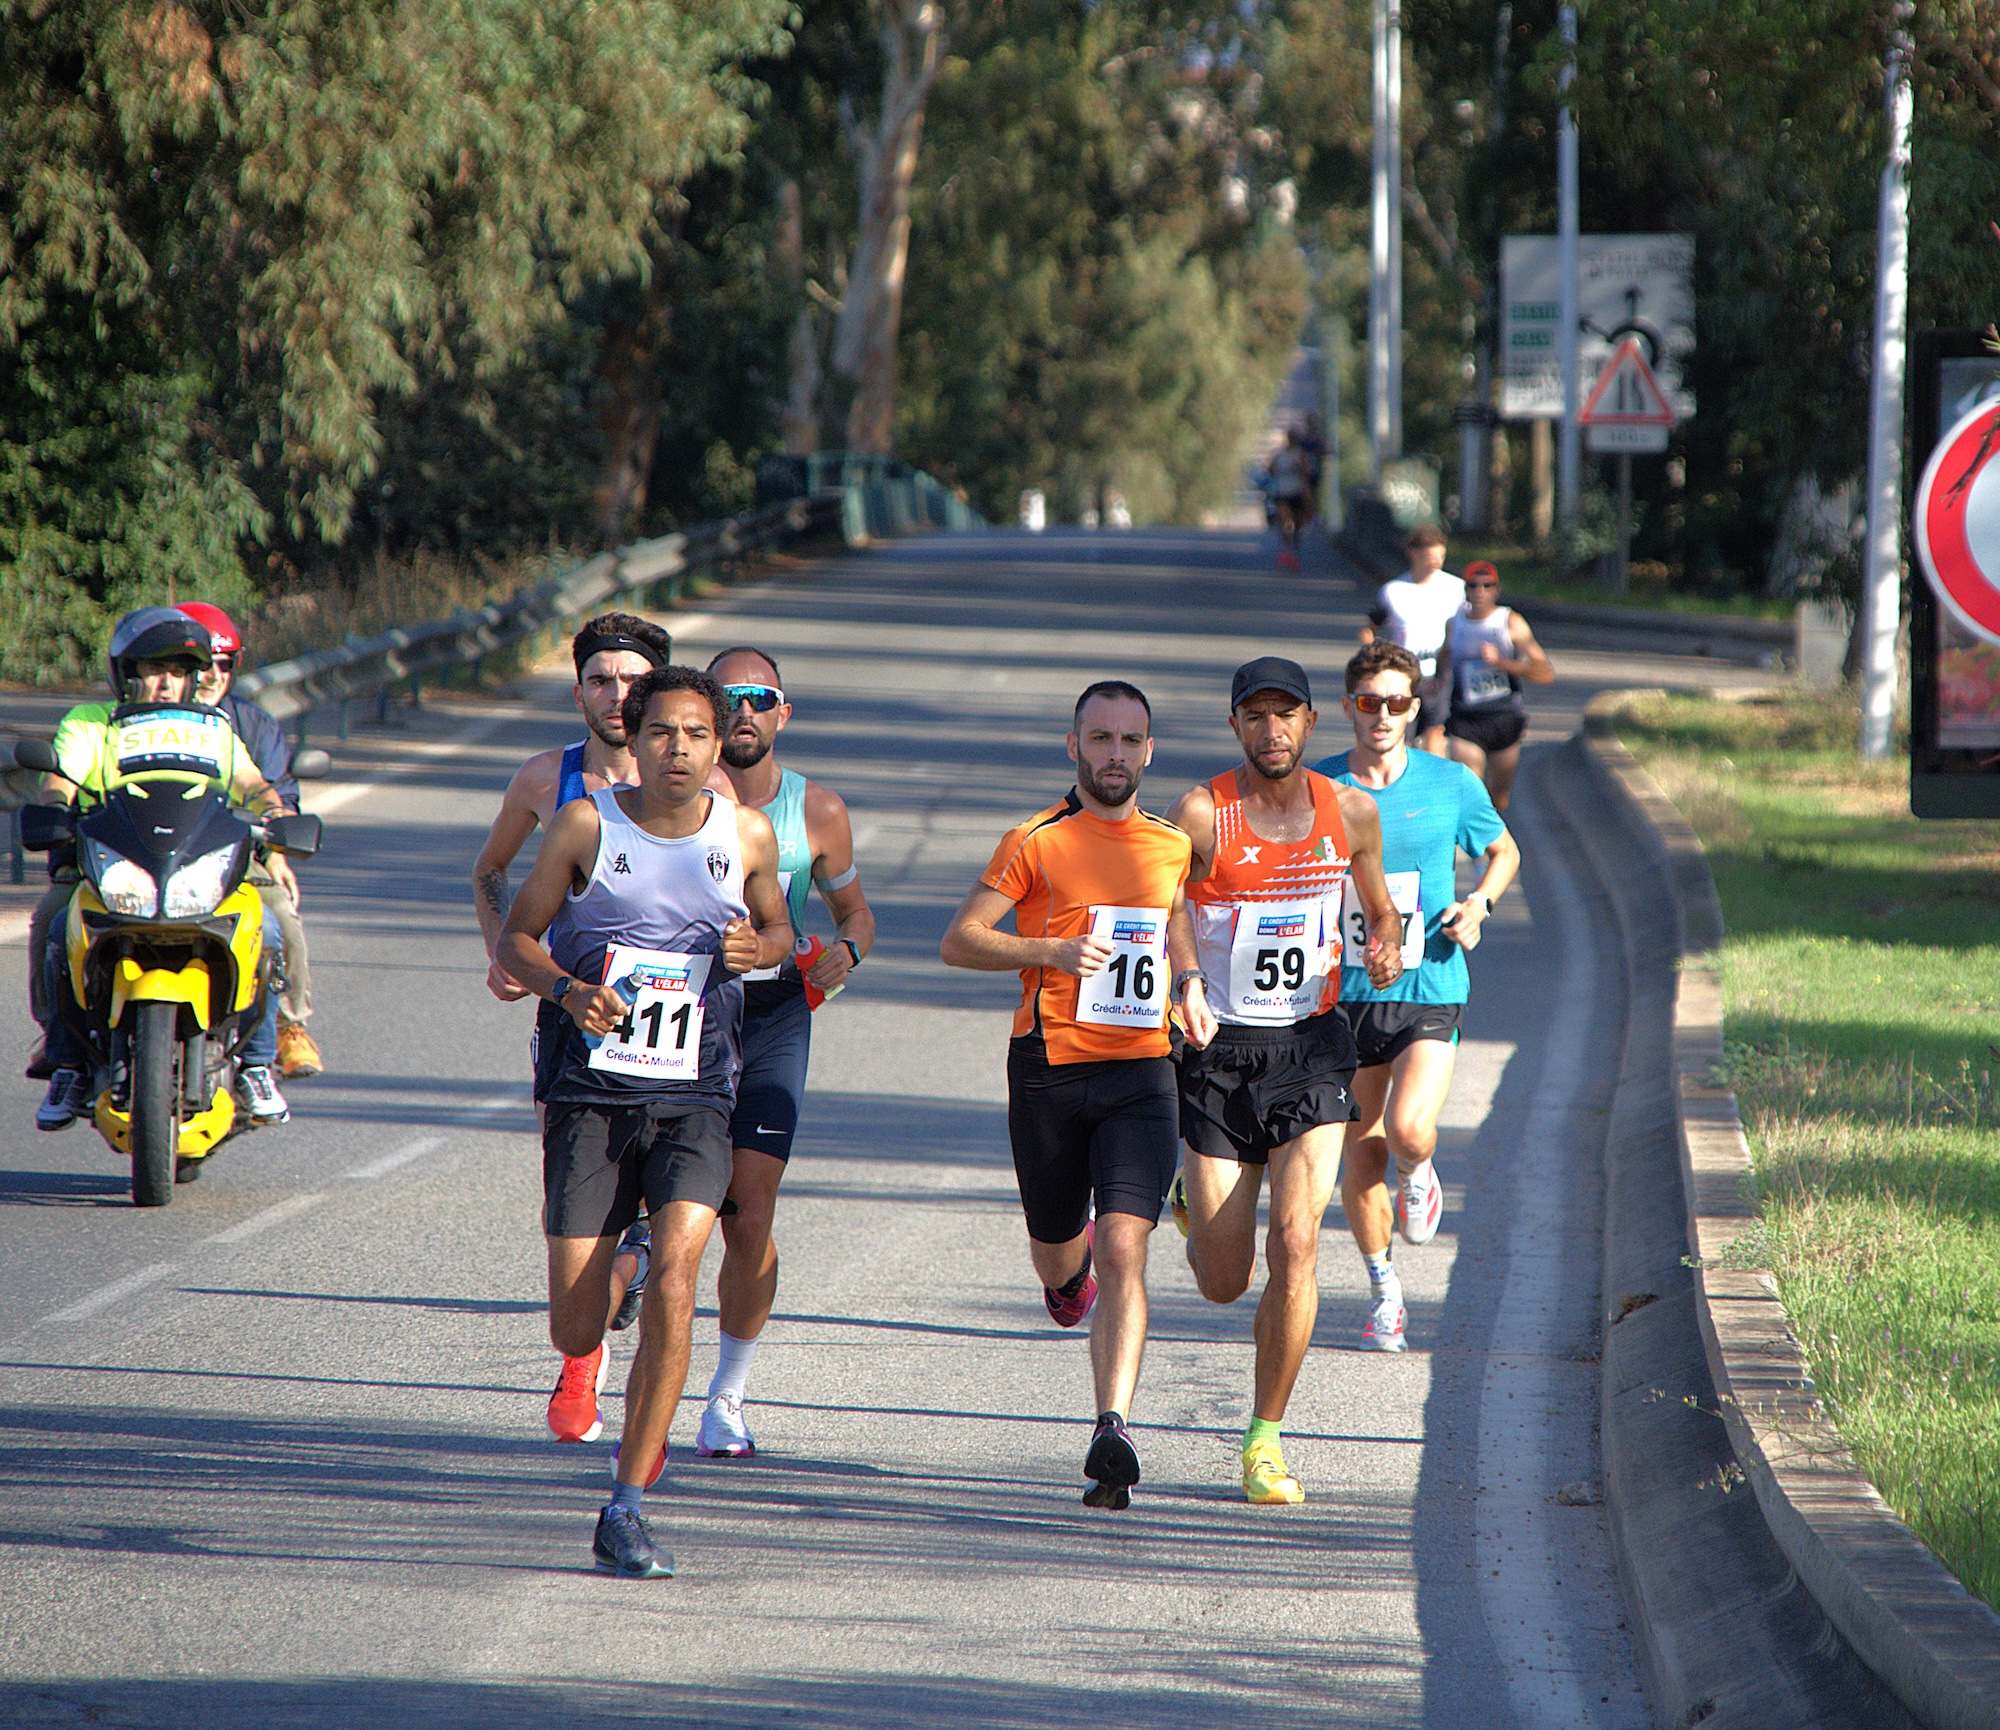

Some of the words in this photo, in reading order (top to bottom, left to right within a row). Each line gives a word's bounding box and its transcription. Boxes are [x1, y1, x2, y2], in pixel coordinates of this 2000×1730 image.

[123, 728, 212, 750] STAFF
[1268, 917, 1287, 925] CRÉDIT
[1351, 912, 1414, 946] 37
[1132, 932, 1154, 942] L'ÉLAN
[1279, 925, 1304, 936] L'ÉLAN
[1108, 954, 1155, 1000] 16
[1254, 947, 1305, 991] 59
[654, 978, 686, 991] L'ÉLAN
[1242, 995, 1272, 1006] Crédit
[1284, 994, 1311, 1006] Mutuel
[1092, 1003, 1122, 1015] Crédit
[1132, 1005, 1161, 1017] Mutuel
[611, 1001, 692, 1049] 411
[606, 1048, 638, 1063] Crédit
[650, 1056, 684, 1067] Mutuel
